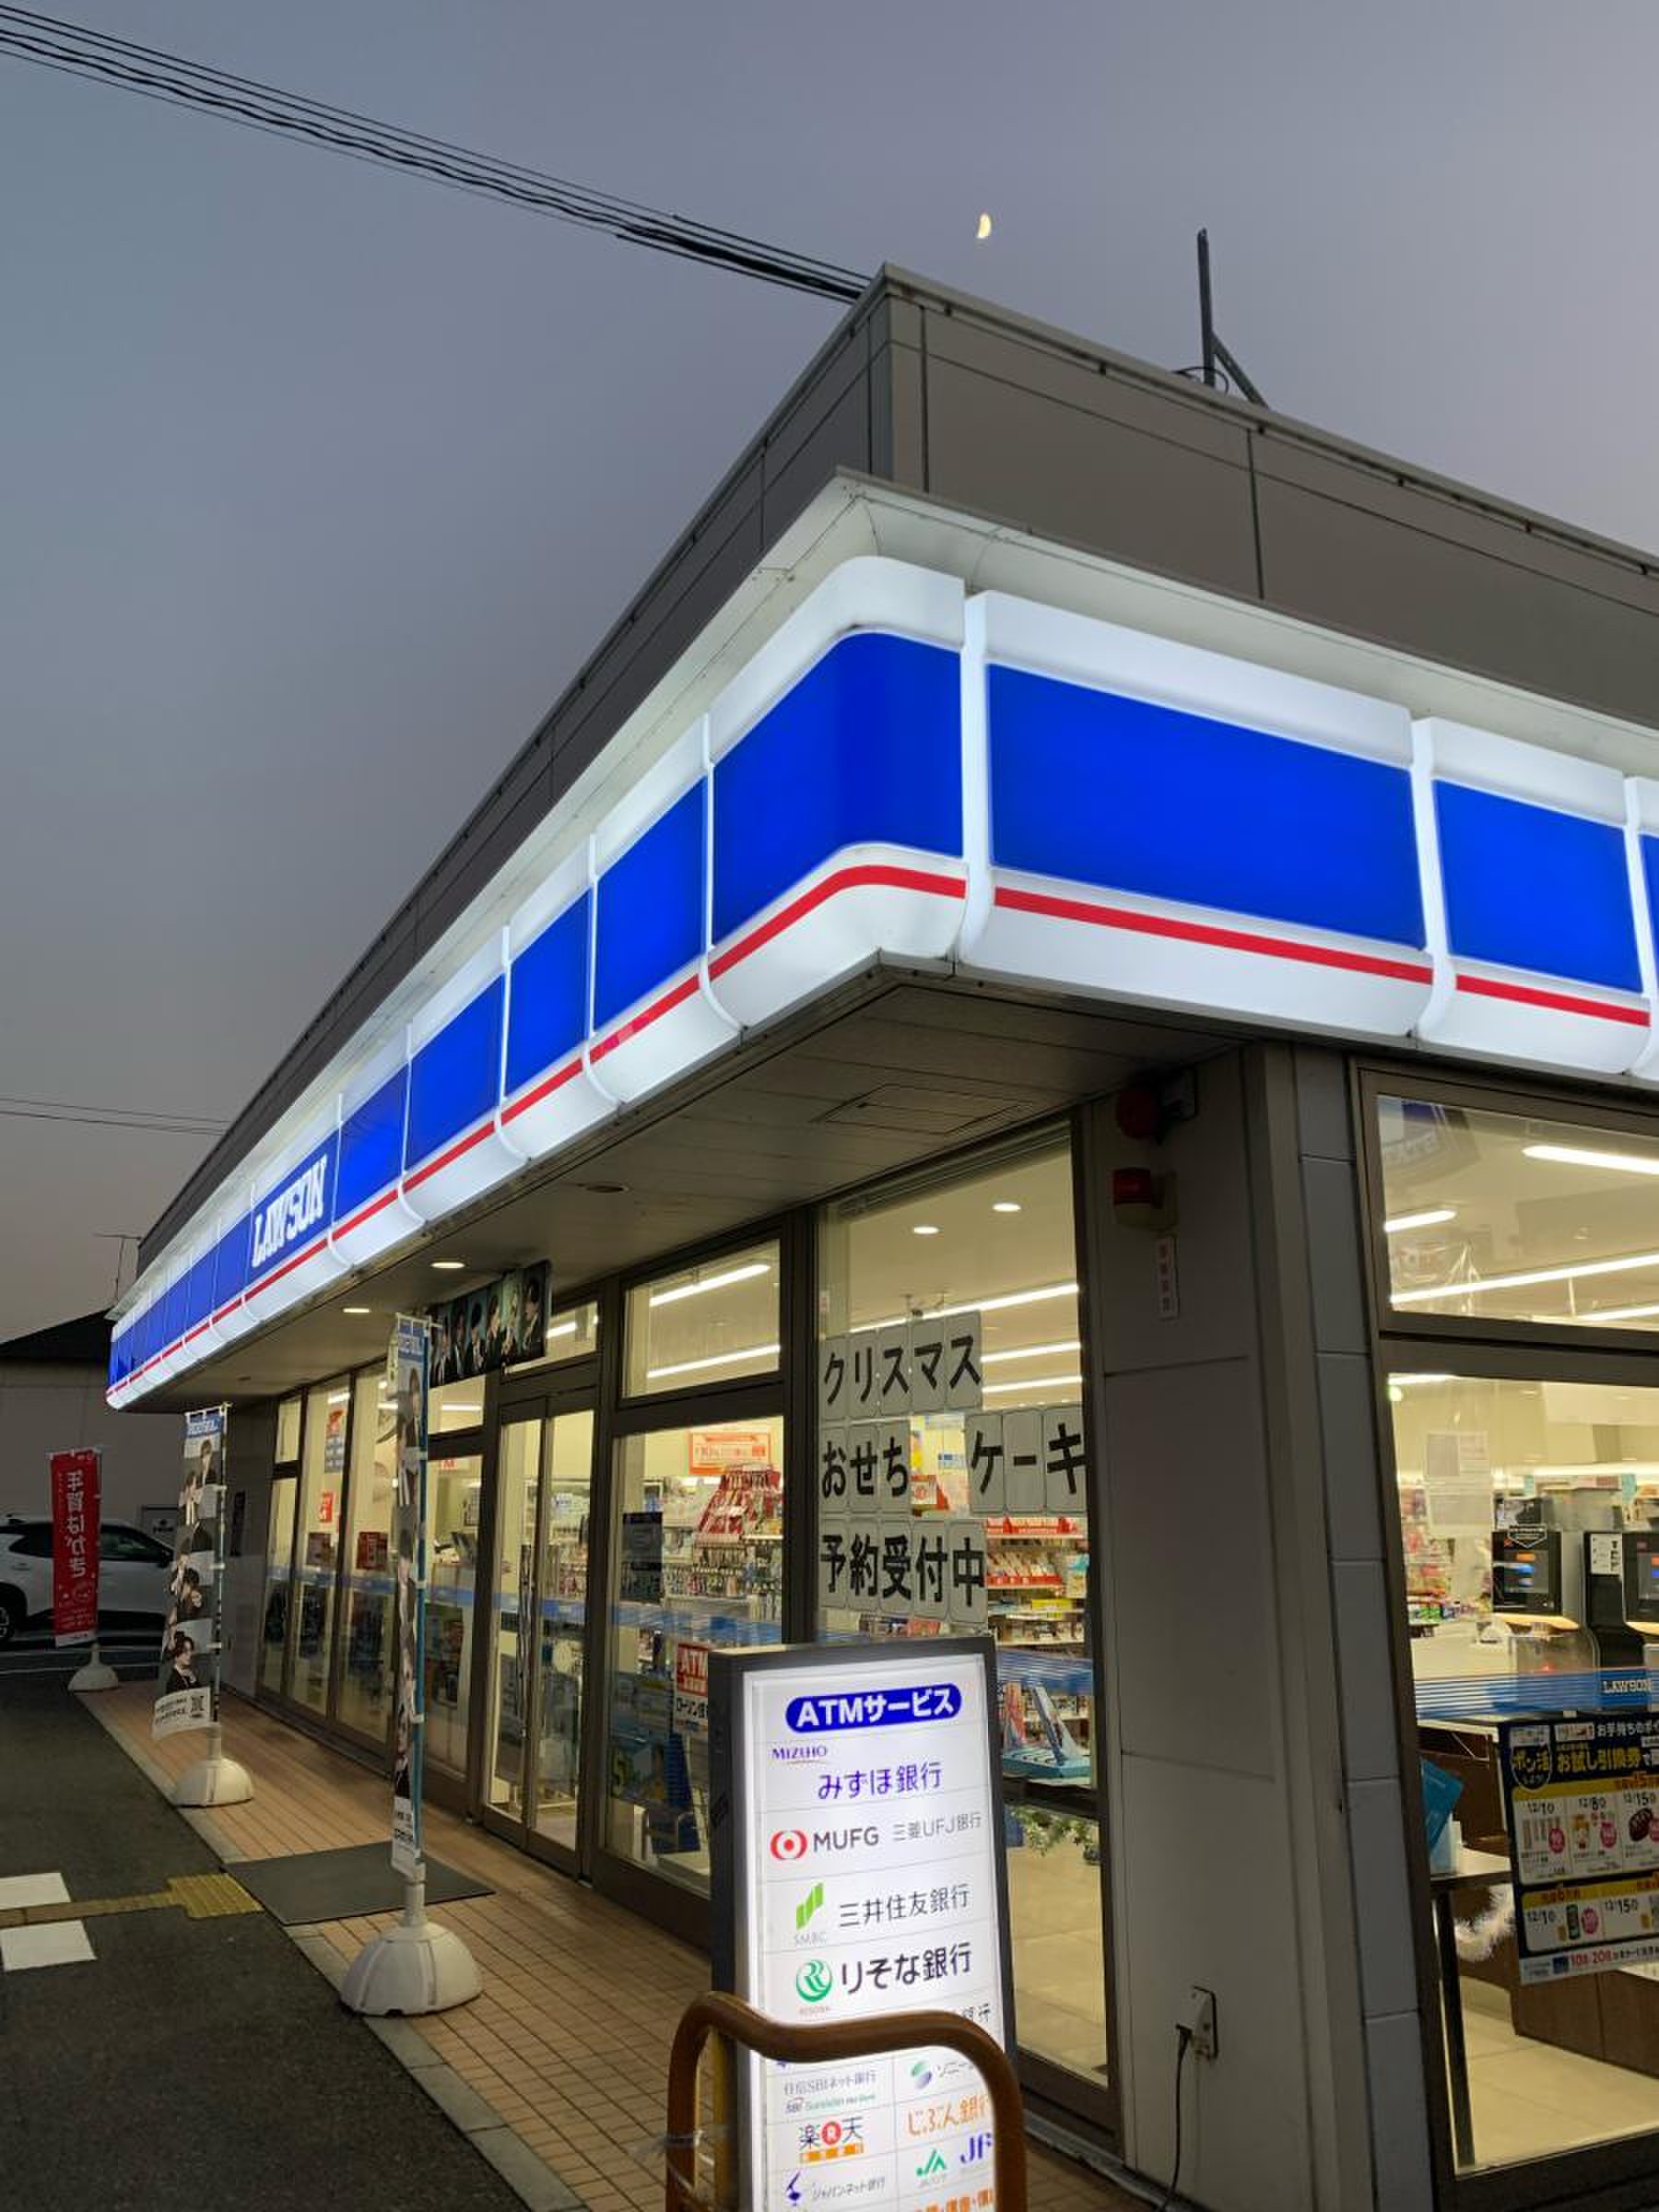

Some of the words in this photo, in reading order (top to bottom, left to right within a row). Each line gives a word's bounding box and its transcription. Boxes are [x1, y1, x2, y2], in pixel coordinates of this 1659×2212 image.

[252, 1153, 327, 1267] LAWSON
[821, 1334, 982, 1406] クリスマス
[820, 1435, 910, 1498] おせち
[971, 1422, 1088, 1495] ケーキ
[819, 1532, 986, 1607] 予約受付中
[795, 1688, 955, 1728] ATMサービス
[817, 1761, 942, 1800] みずほ銀行
[813, 1826, 879, 1853] MUFG
[892, 1812, 982, 1841] 三菱UFJ銀行
[840, 1883, 971, 1928] 三井住友銀行
[841, 1941, 971, 1994] りそな銀行
